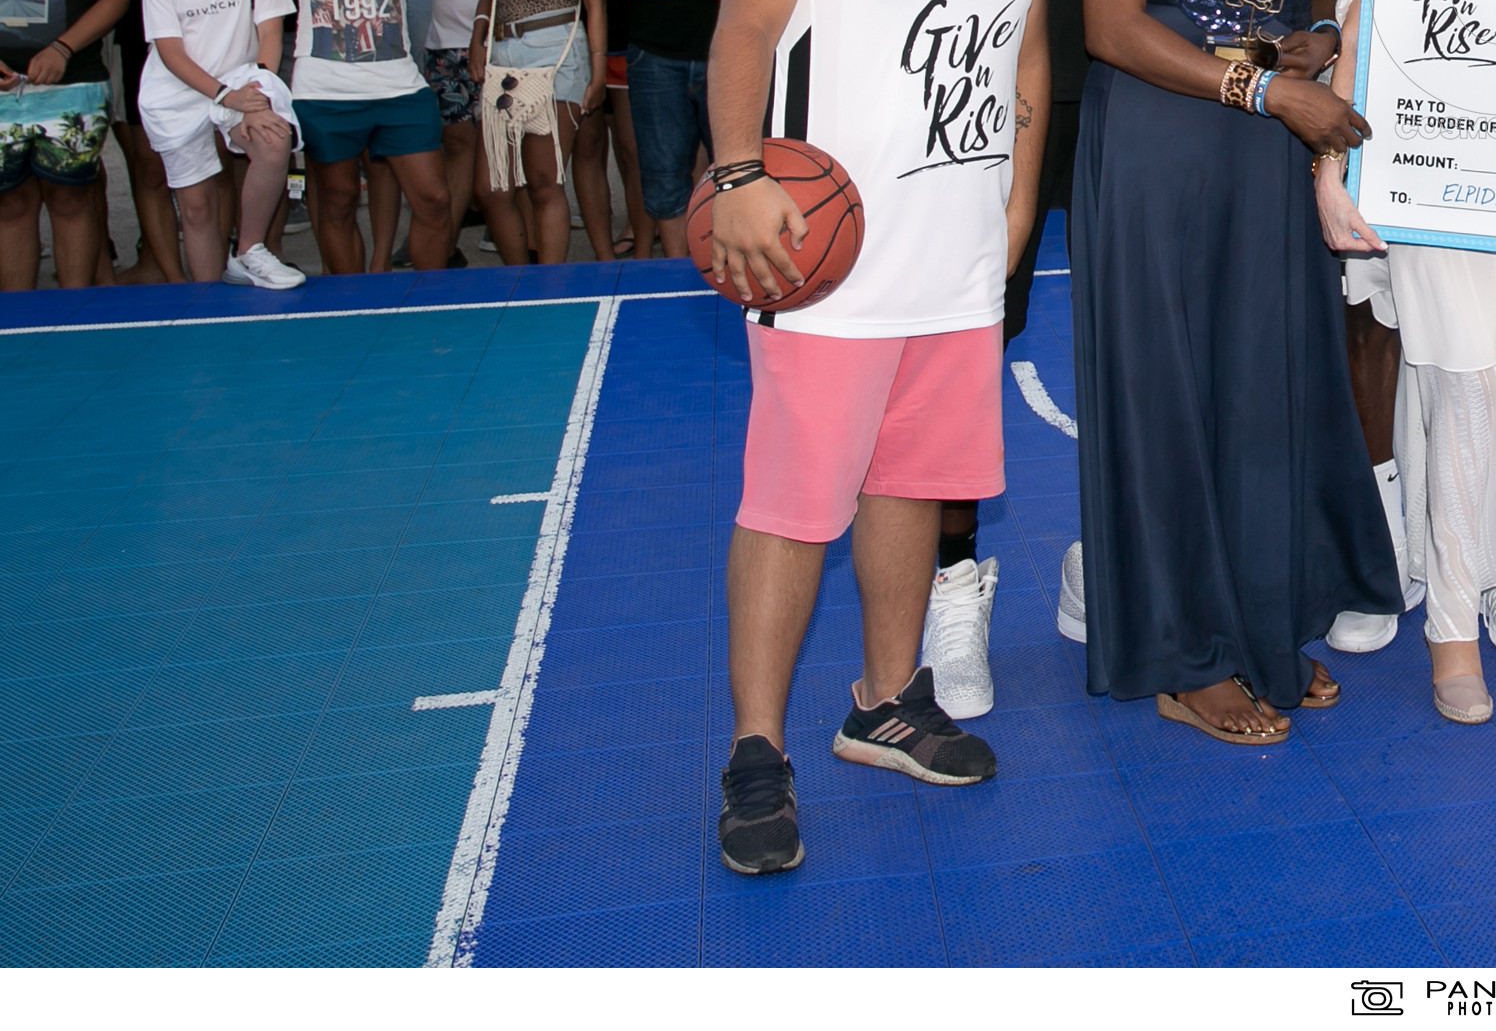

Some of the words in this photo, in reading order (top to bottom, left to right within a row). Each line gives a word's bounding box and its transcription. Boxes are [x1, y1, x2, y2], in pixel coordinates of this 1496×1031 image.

[186, 0, 239, 17] GIVNCH
[1460, 1, 1478, 16] n
[975, 64, 994, 88] n
[1397, 98, 1423, 113] PAY
[1428, 100, 1446, 114] TO
[925, 75, 1010, 164] Rise
[1396, 113, 1424, 128] THE
[1427, 116, 1475, 132] ORDER
[1392, 153, 1458, 170] AMOUNT:
[1389, 191, 1412, 205] TO:
